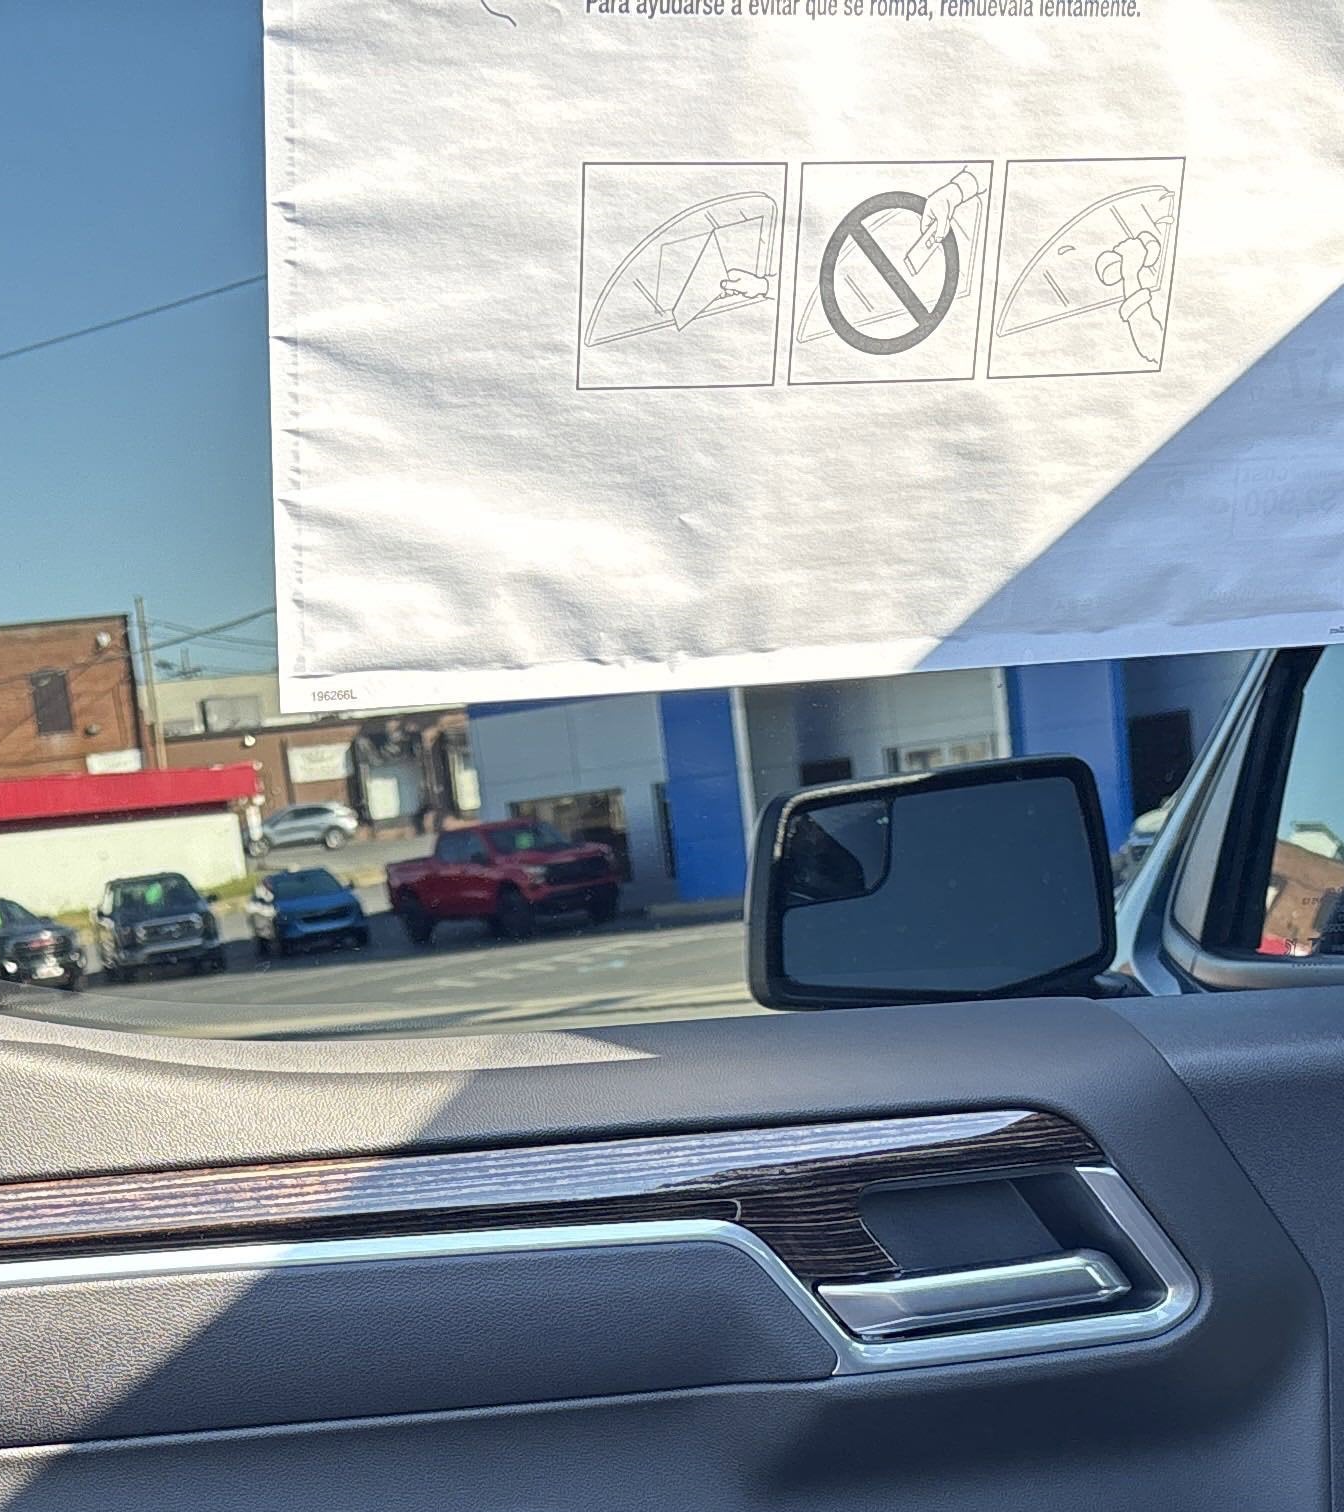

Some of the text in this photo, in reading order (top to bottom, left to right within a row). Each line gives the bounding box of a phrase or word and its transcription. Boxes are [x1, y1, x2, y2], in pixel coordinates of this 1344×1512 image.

[586, 0, 630, 14] Para
[636, 0, 725, 19] ayudarse
[731, 0, 743, 15] a
[749, 0, 798, 16] evitar
[805, 0, 838, 20] que
[843, 0, 864, 16] se
[869, 0, 934, 21] rompa,
[1039, 0, 1141, 17] lentamente.
